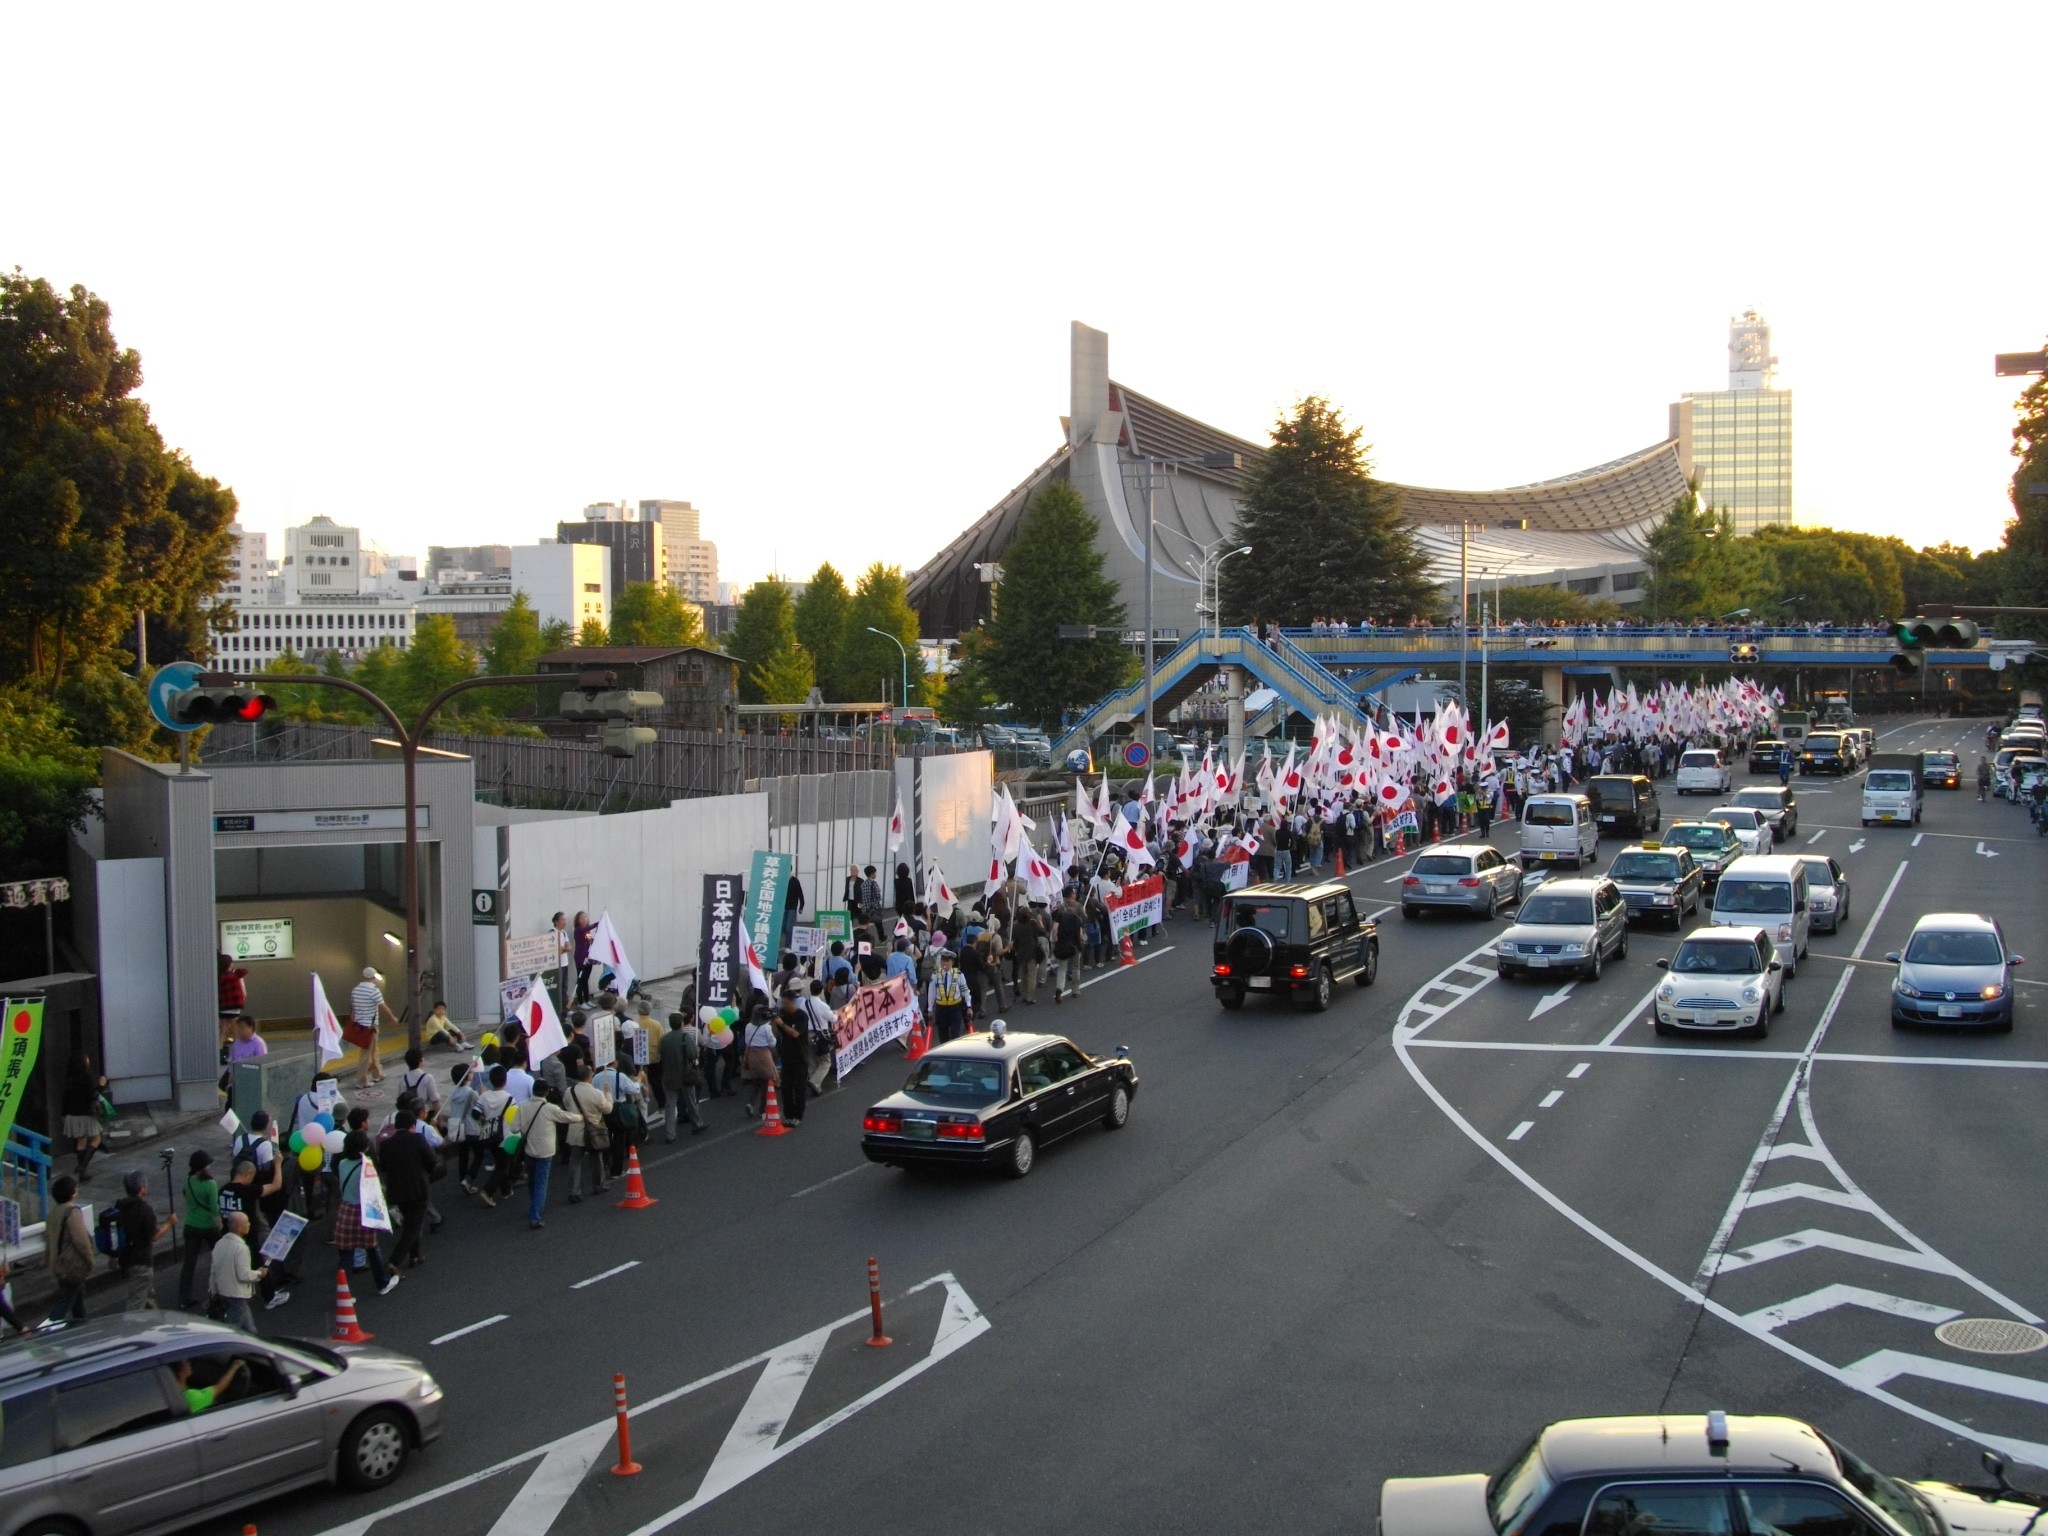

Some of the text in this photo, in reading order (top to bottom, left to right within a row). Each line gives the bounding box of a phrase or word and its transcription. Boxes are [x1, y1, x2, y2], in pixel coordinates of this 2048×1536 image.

[2, 880, 69, 908] 迎賓館
[708, 880, 733, 1002] 日本解体阻止
